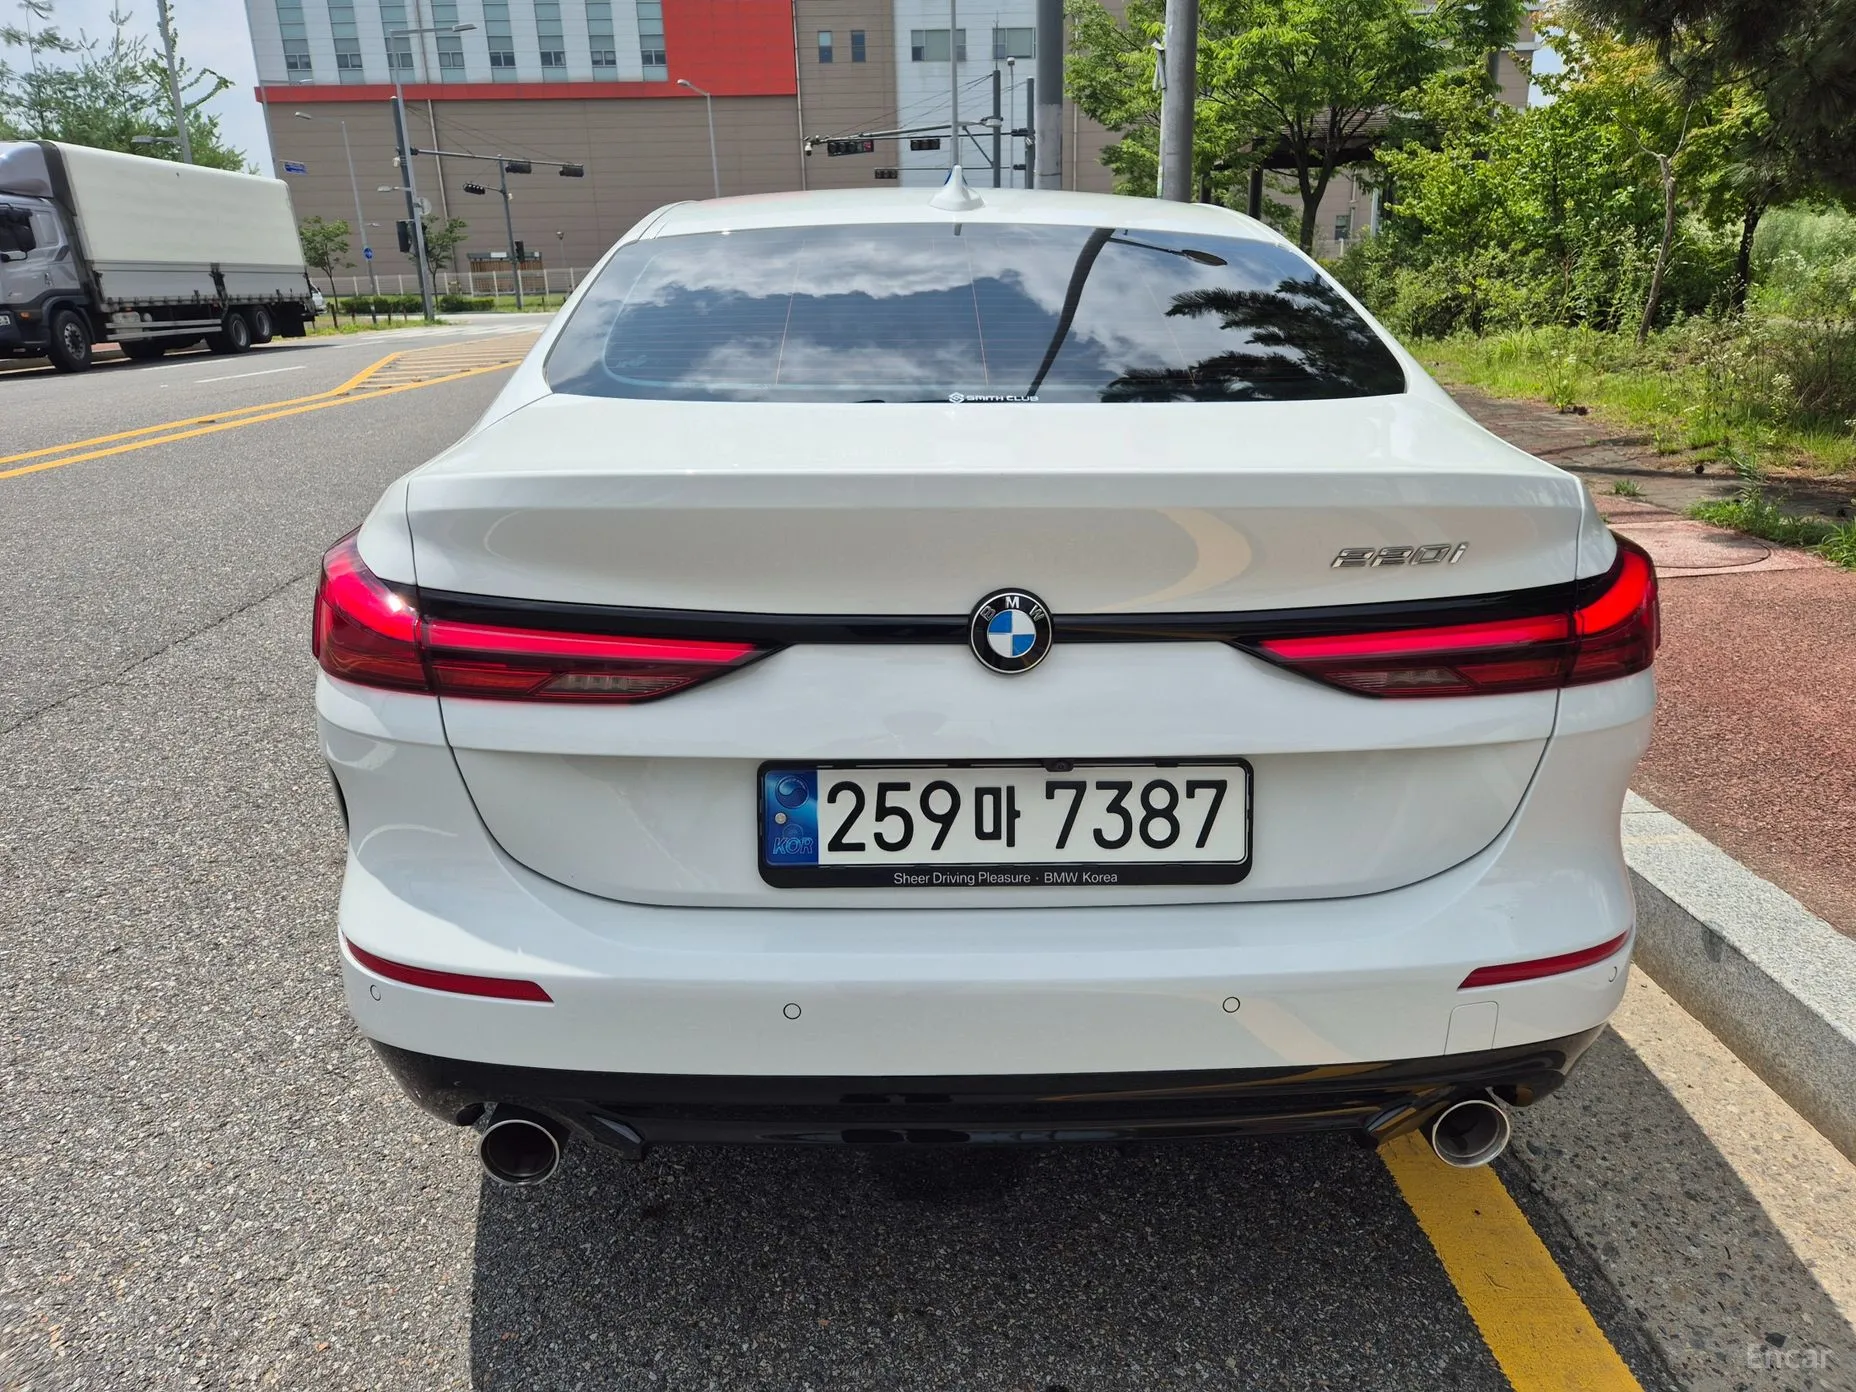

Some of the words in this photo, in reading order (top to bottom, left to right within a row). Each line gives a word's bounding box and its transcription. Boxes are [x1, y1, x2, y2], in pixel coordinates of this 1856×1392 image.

[1330, 541, 1469, 568] 220i
[980, 596, 1045, 622] BMW
[826, 779, 1022, 853] 259마
[1044, 778, 1229, 850] 7387
[772, 837, 814, 855] KOR
[893, 872, 930, 884] Sheer
[932, 872, 976, 886] Driving
[978, 871, 1031, 883] Pleasure
[1044, 871, 1079, 883] BMW
[1082, 871, 1118, 883] Korea
